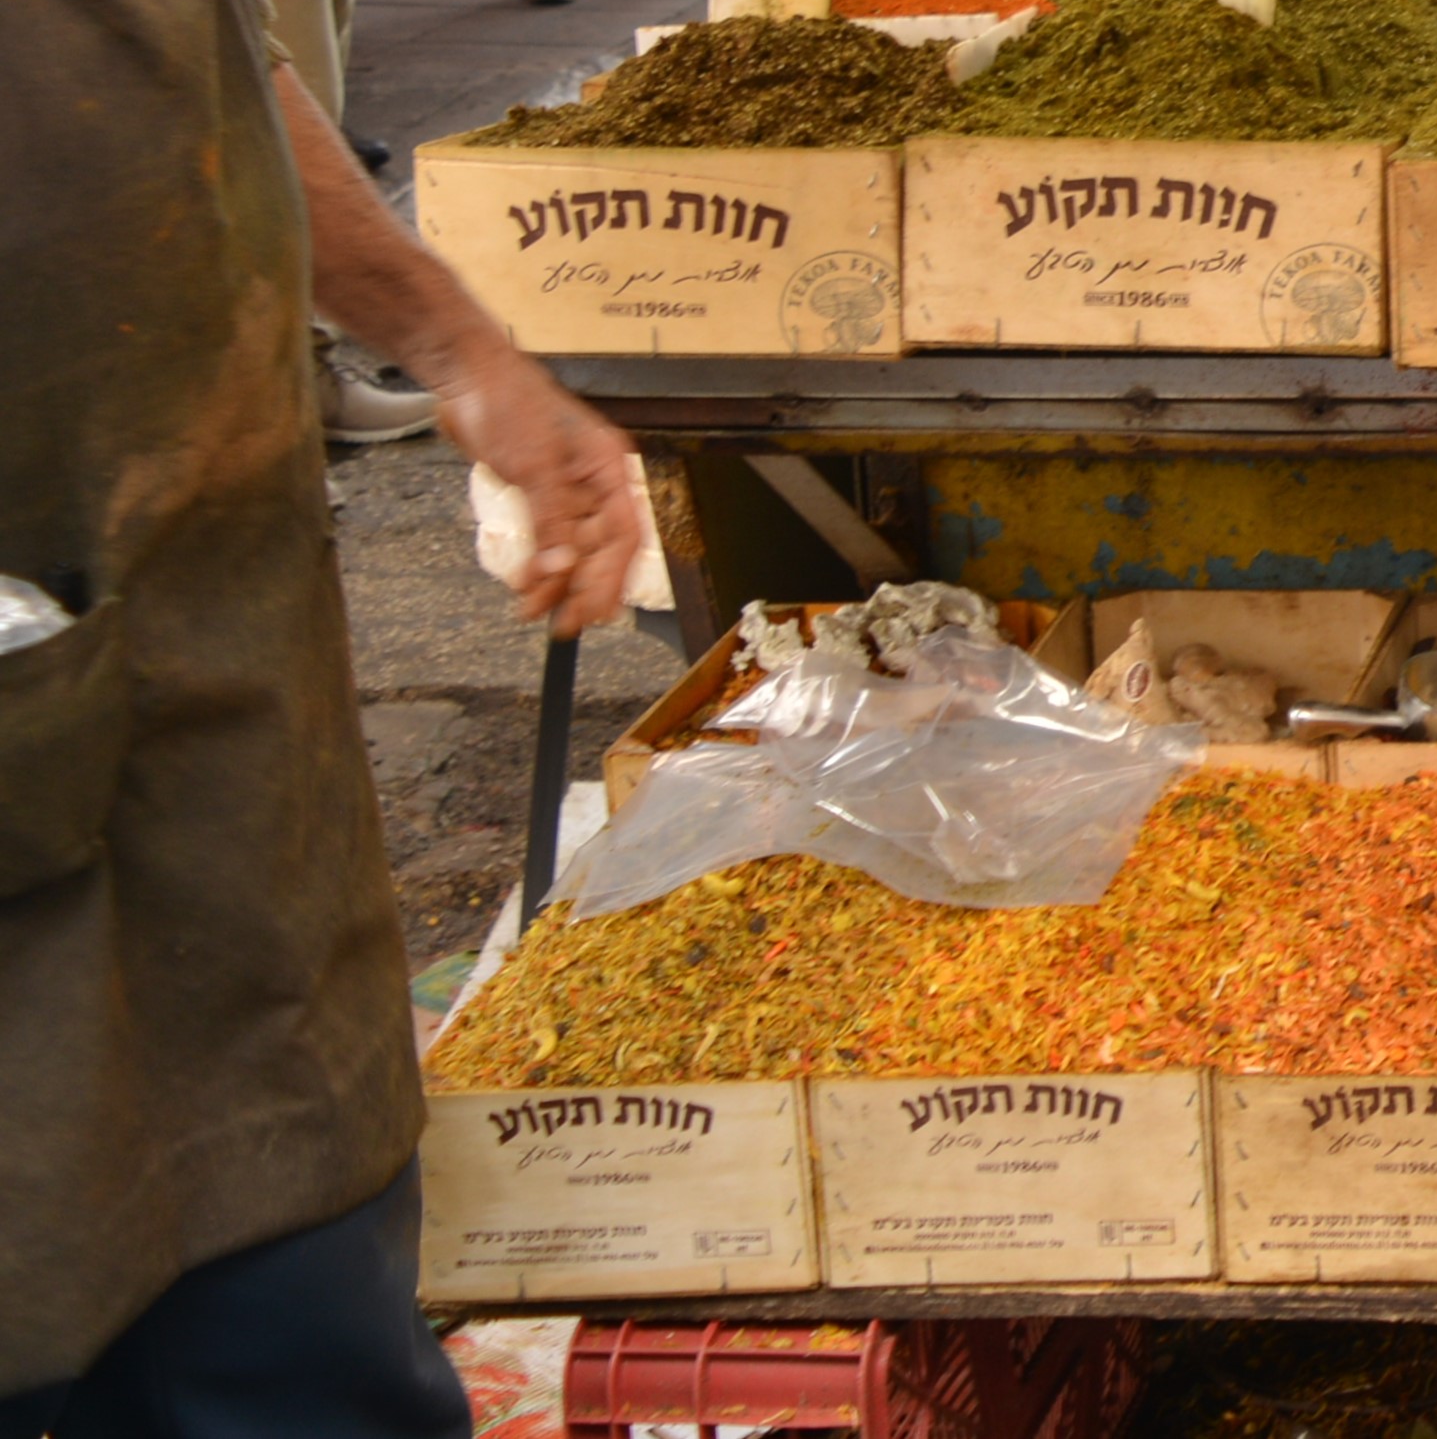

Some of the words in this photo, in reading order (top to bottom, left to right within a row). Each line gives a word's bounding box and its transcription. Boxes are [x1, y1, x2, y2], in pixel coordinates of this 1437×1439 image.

[662, 190, 791, 249] חוות
[1150, 177, 1278, 240] חוות
[633, 302, 687, 318] 1986
[1117, 290, 1168, 308] 1986
[613, 1095, 715, 1136] חוות
[1024, 1083, 1124, 1125] חוות
[1000, 1160, 1043, 1174] 1986
